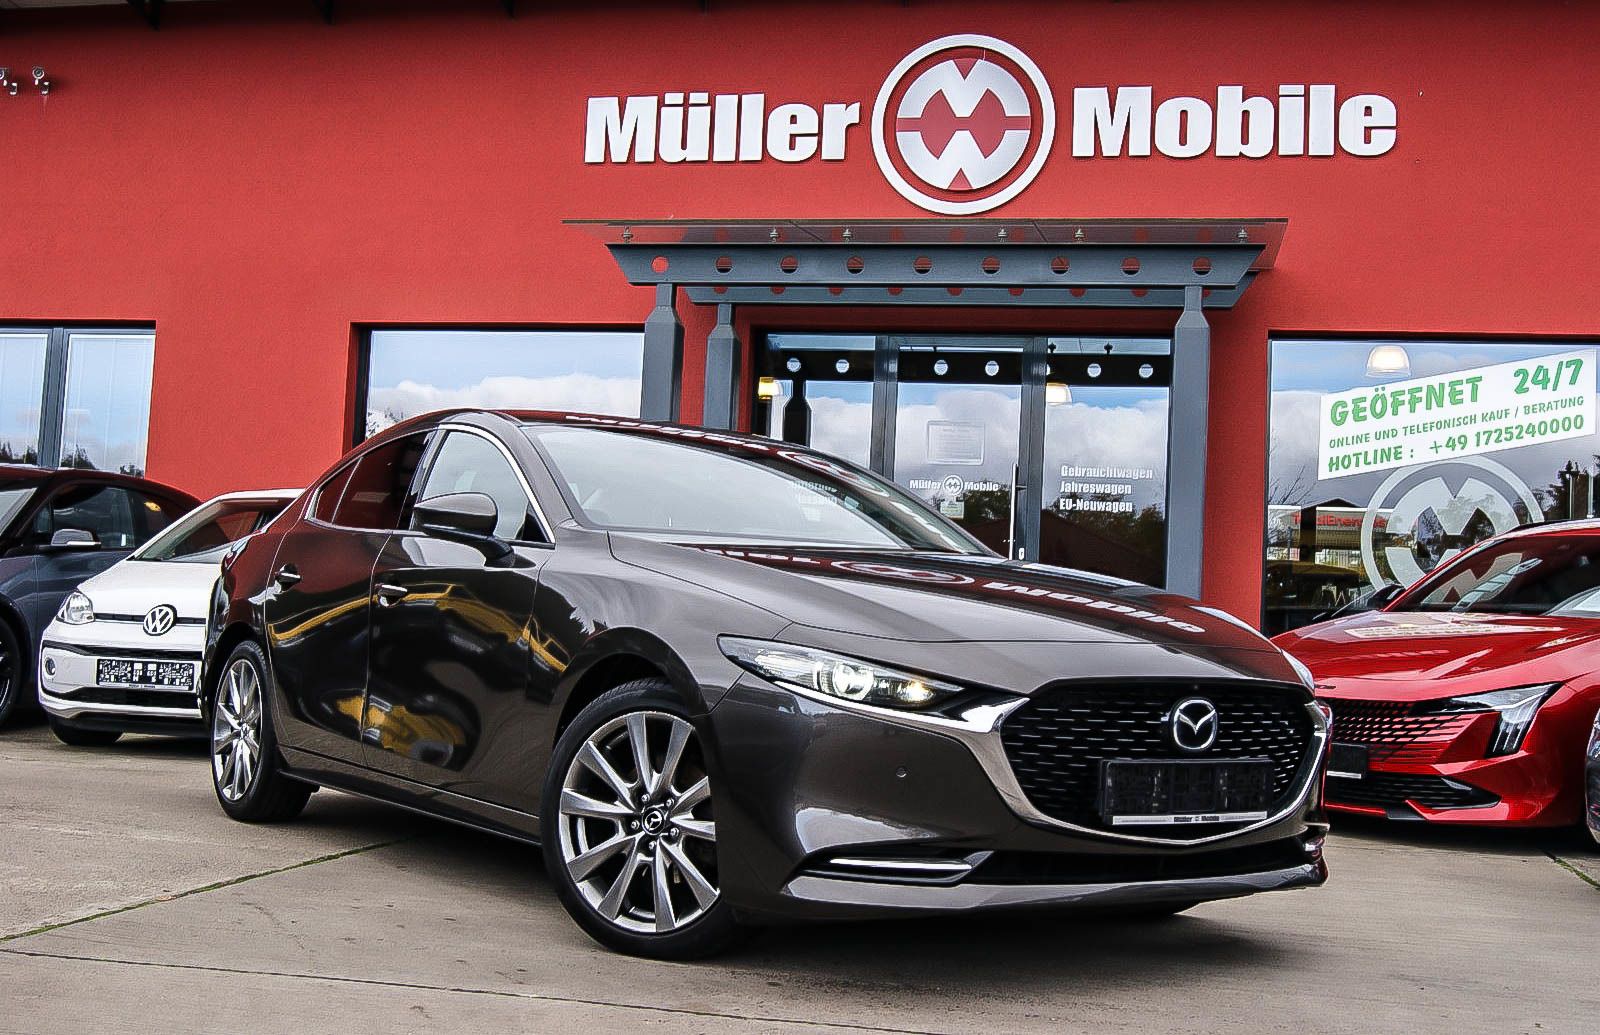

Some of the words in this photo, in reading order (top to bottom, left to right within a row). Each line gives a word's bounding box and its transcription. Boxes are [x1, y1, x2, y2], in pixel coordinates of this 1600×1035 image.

[584, 92, 860, 164] Müller
[1072, 84, 1397, 158] Mobile
[1330, 375, 1483, 427] GEÖFFNET
[1513, 358, 1584, 395] 24/7
[1328, 444, 1403, 472] HOTLINE
[1429, 434, 1468, 454] +49
[1475, 414, 1584, 448] 1725240000
[1329, 432, 1371, 449] ONLINE
[1374, 428, 1398, 441] UND
[1402, 413, 1477, 436] TELEFONISCH
[1481, 408, 1511, 423] KAUF
[1523, 395, 1584, 415] BERATUNG
[1060, 481, 1132, 495] Jahreswagen
[1061, 464, 1153, 480] Gebrauchtwagen
[1060, 498, 1133, 513] EU-Neuwagen
